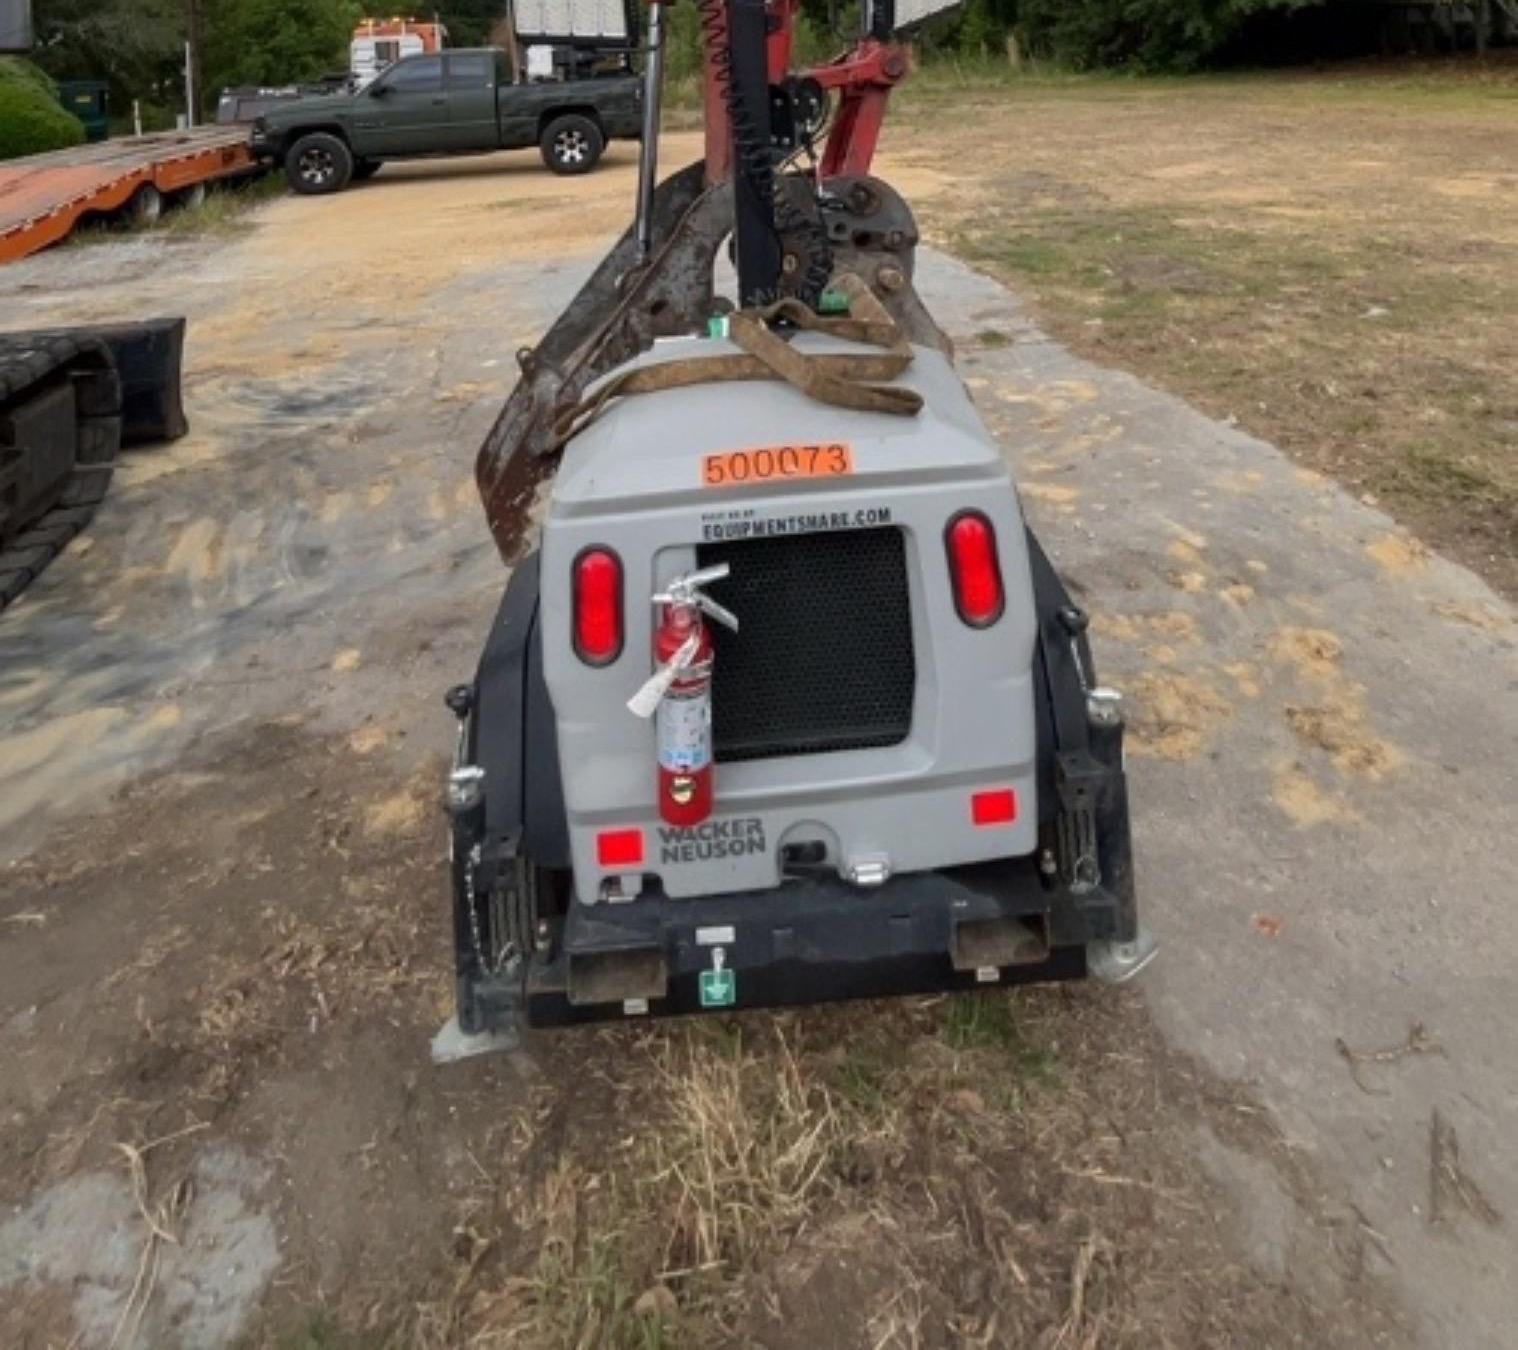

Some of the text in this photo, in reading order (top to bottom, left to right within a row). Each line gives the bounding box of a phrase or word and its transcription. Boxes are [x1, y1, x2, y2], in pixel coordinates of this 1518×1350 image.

[706, 444, 848, 484] 500073
[703, 508, 892, 540] EQUIPMENTSHARE.COM
[657, 818, 764, 843] WACKER
[662, 837, 766, 864] NEUSON
